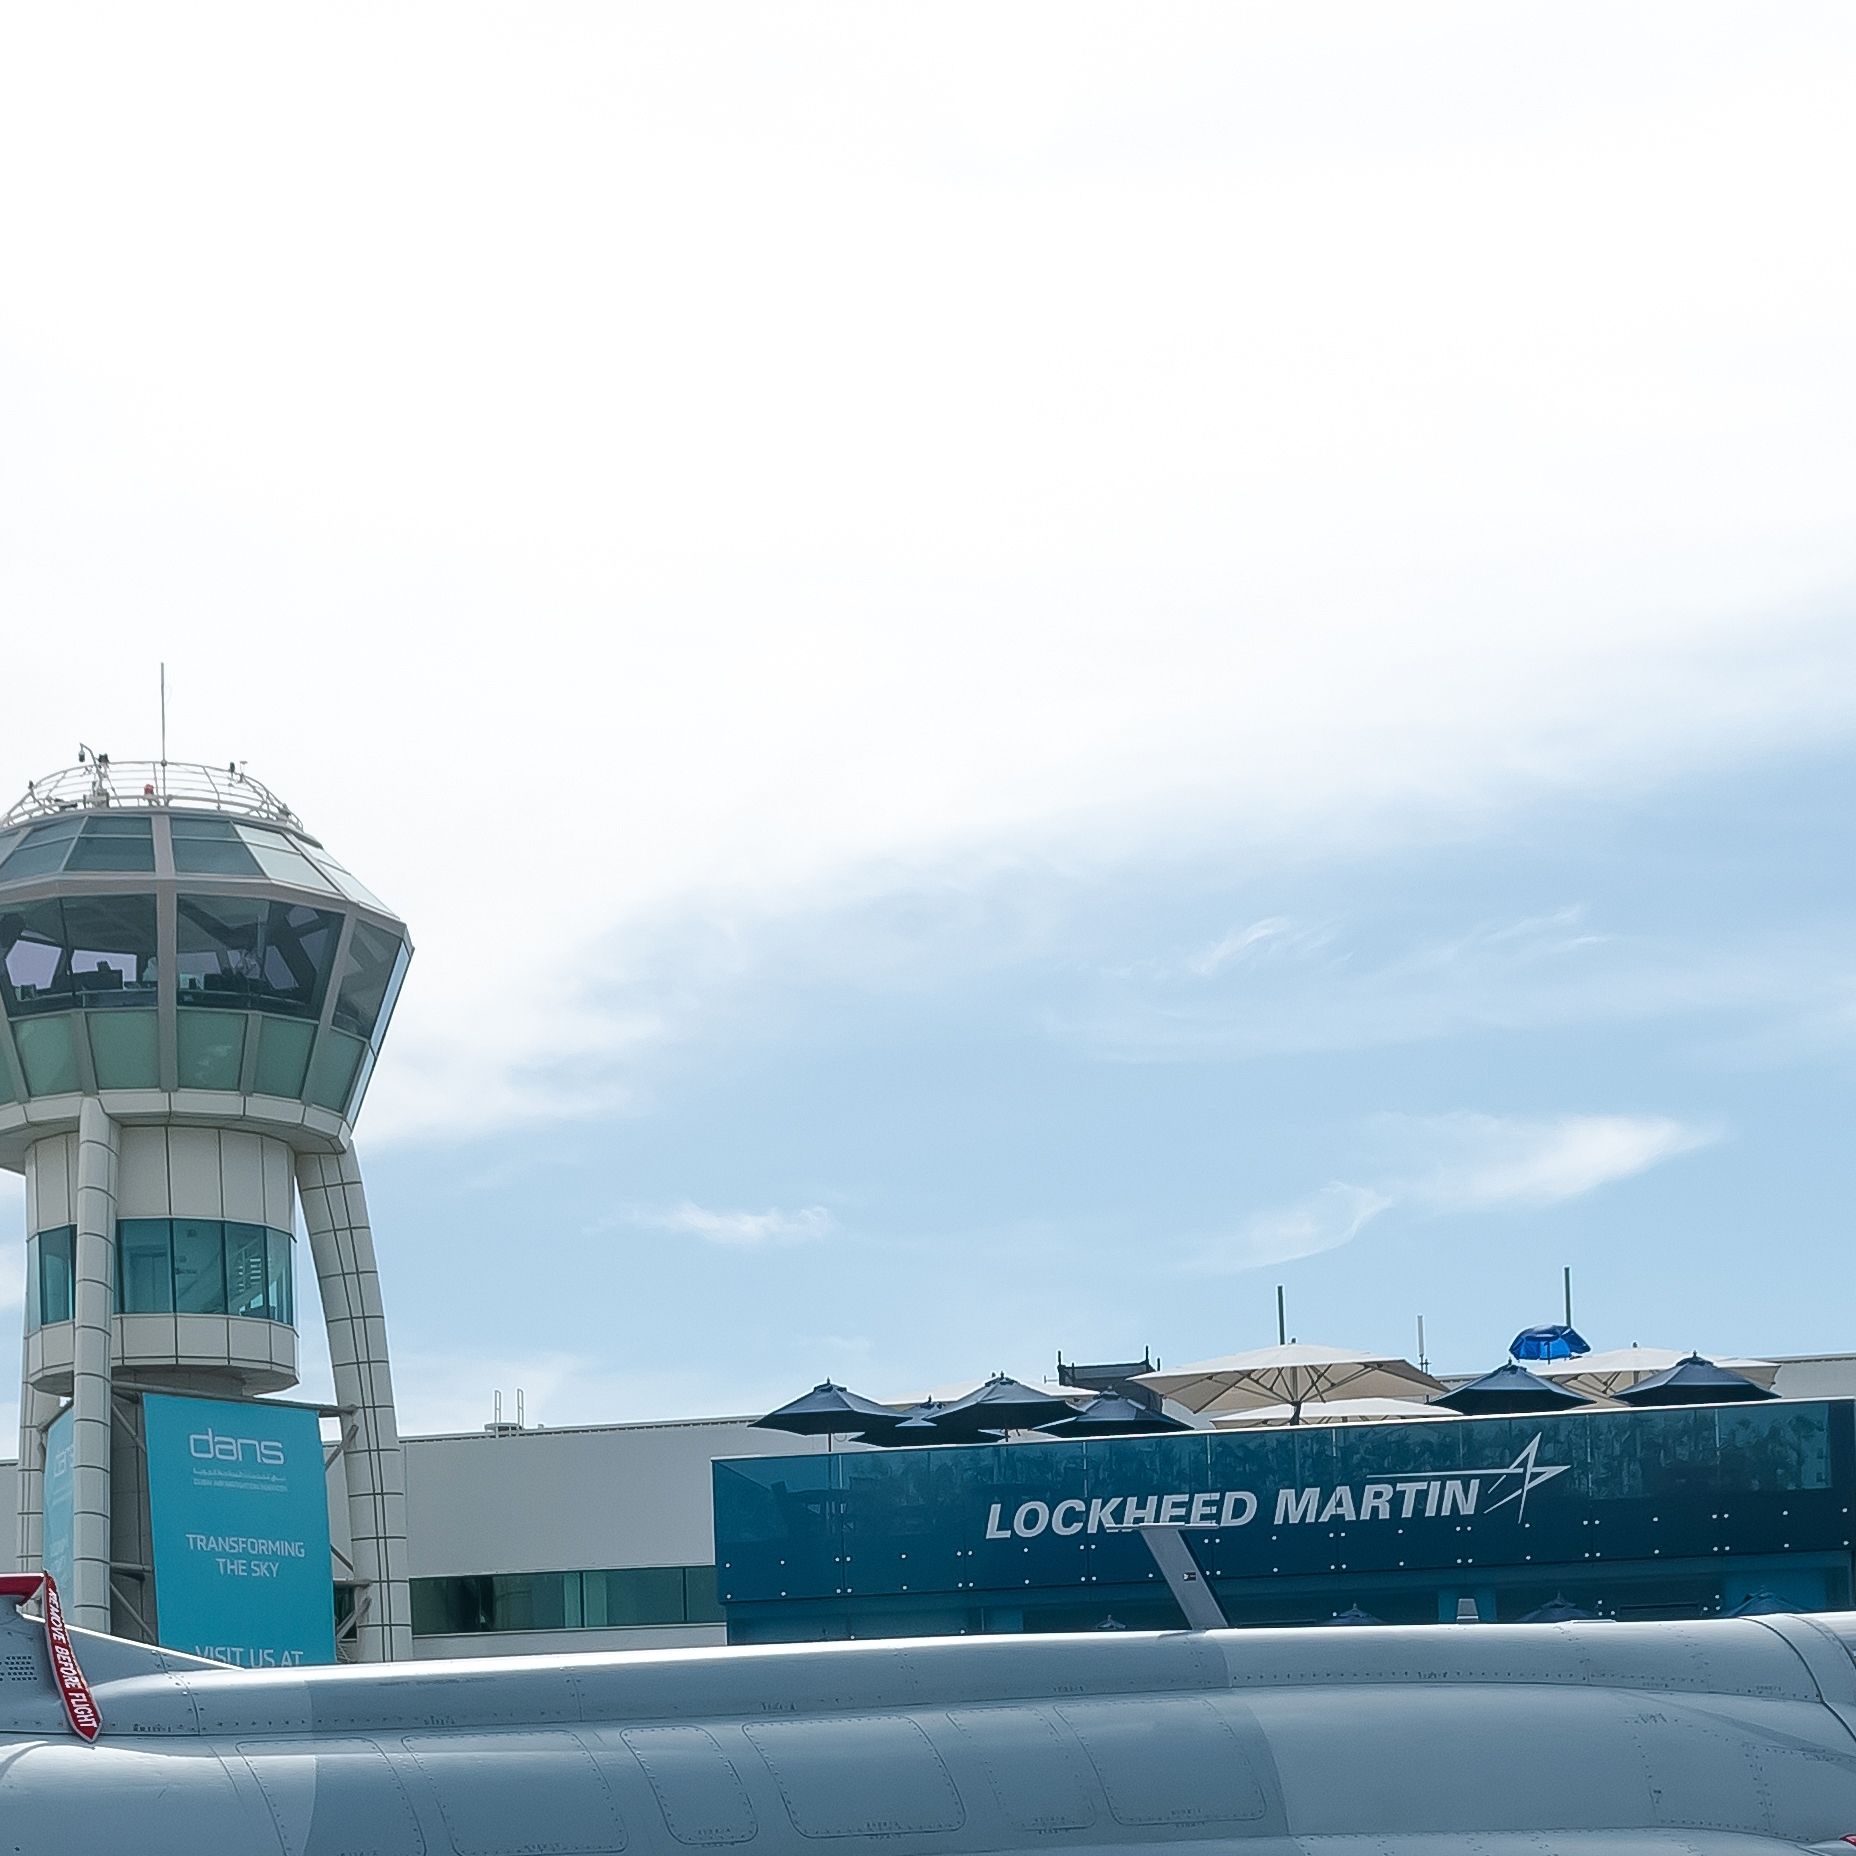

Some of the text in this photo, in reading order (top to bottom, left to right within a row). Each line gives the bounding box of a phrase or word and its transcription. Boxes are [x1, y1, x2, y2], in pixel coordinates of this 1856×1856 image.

[189, 1428, 285, 1465] dans
[985, 1478, 1479, 1540] LOCKHEED MARTIN
[186, 1534, 305, 1557] TRANSFORMING
[216, 1558, 279, 1578] THE SKY
[48, 1588, 66, 1644] REMOVE
[55, 1645, 82, 1690] BEFORE
[248, 1649, 275, 1667] US
[280, 1651, 304, 1667] AT
[68, 1692, 97, 1728] FLIGHT
